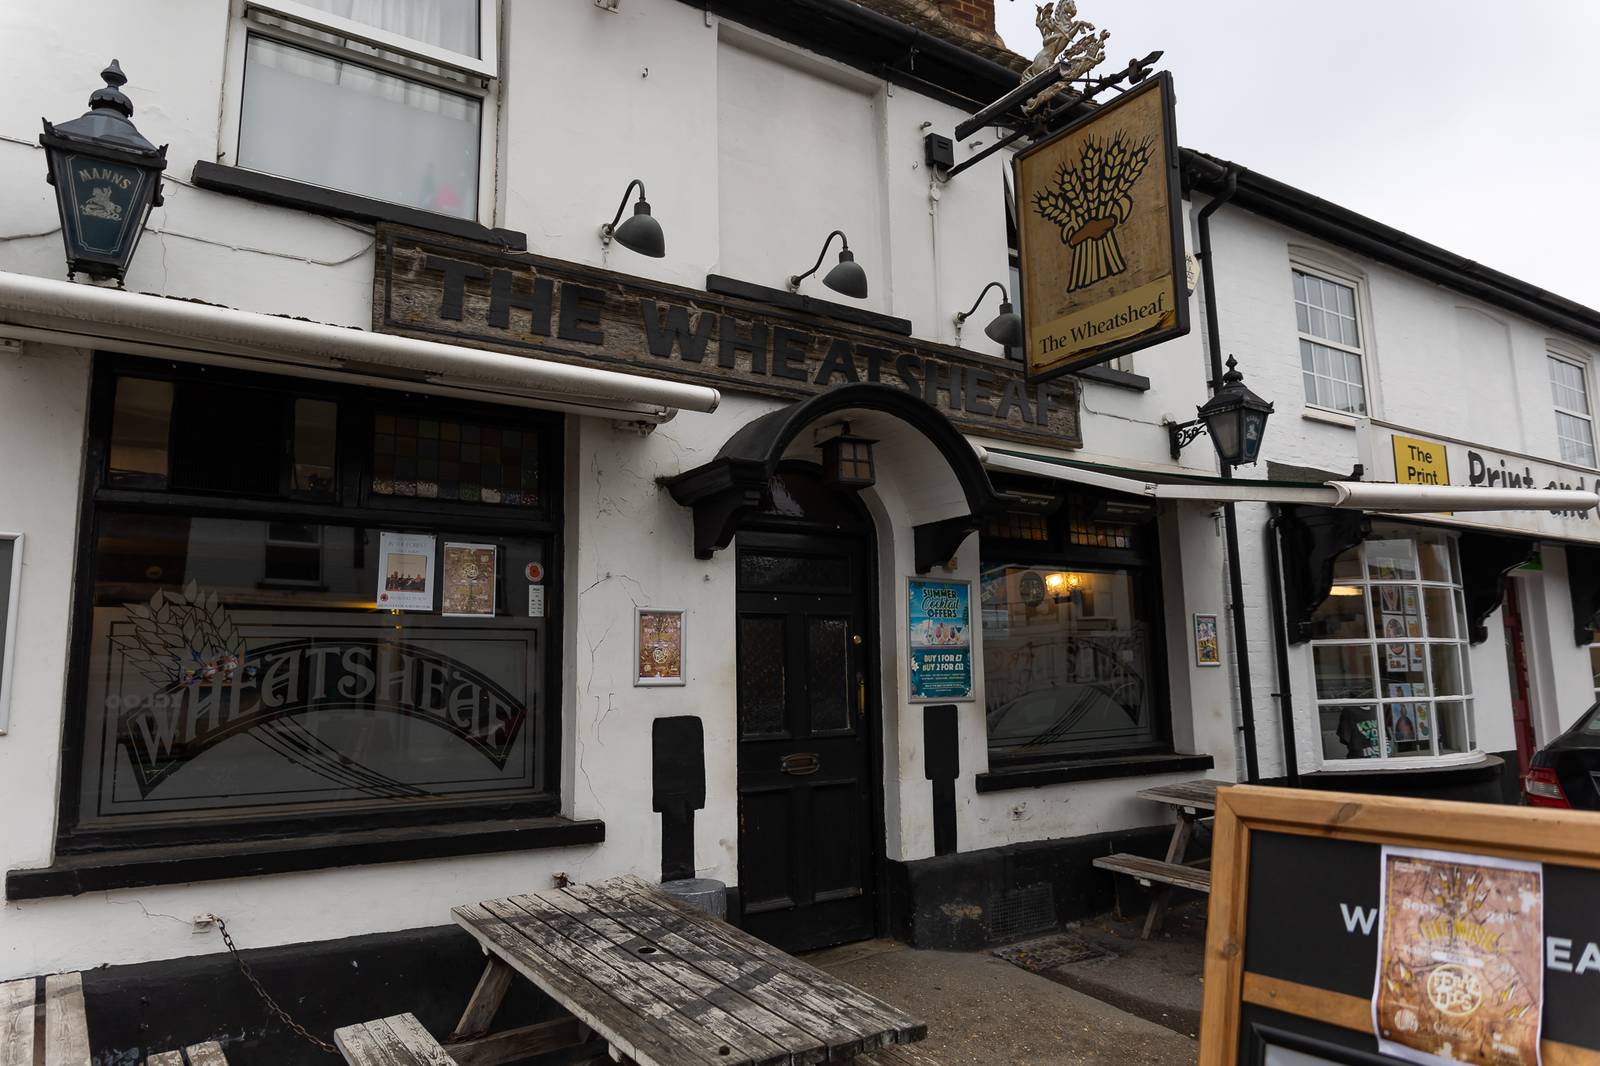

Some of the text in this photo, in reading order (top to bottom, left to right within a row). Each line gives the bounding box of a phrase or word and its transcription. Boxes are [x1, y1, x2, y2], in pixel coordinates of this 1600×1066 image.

[79, 167, 131, 189] MANNS
[1039, 292, 1165, 354] The Wheatsheaf
[424, 254, 1064, 427] THE WHEATSHEAF
[1408, 444, 1432, 463] The
[1408, 465, 1438, 485] Print
[921, 596, 960, 611] Cocktail
[923, 589, 957, 599] SUMMER
[927, 609, 957, 618] OFFERS
[922, 663, 935, 671] BUY
[941, 663, 954, 671] FOR
[941, 654, 954, 662] FOR
[135, 646, 515, 768] WHEATSHEAF
